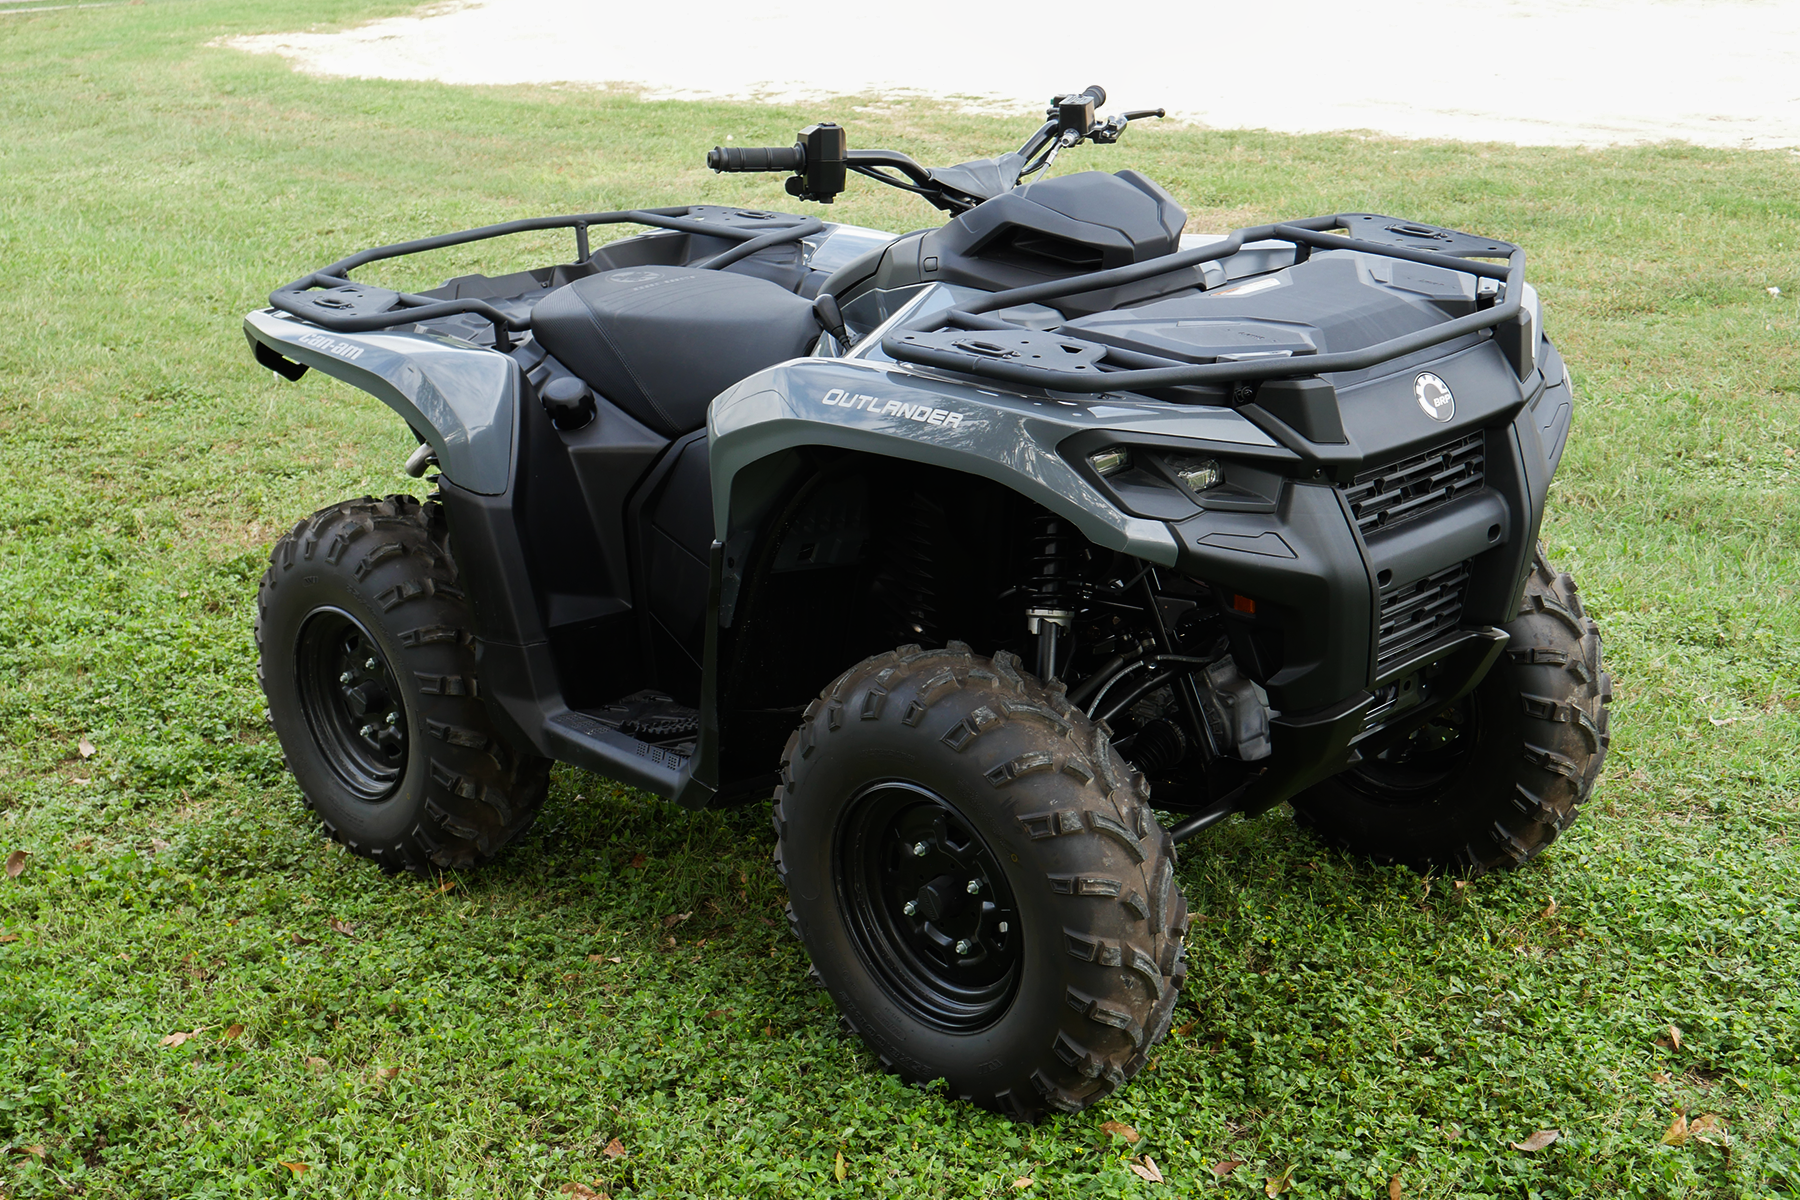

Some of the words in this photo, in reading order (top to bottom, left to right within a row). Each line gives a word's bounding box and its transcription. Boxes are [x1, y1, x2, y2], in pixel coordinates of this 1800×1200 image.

[298, 333, 365, 361] can-am
[821, 388, 964, 429] OUTLANDER
[1433, 393, 1451, 408] BRP
